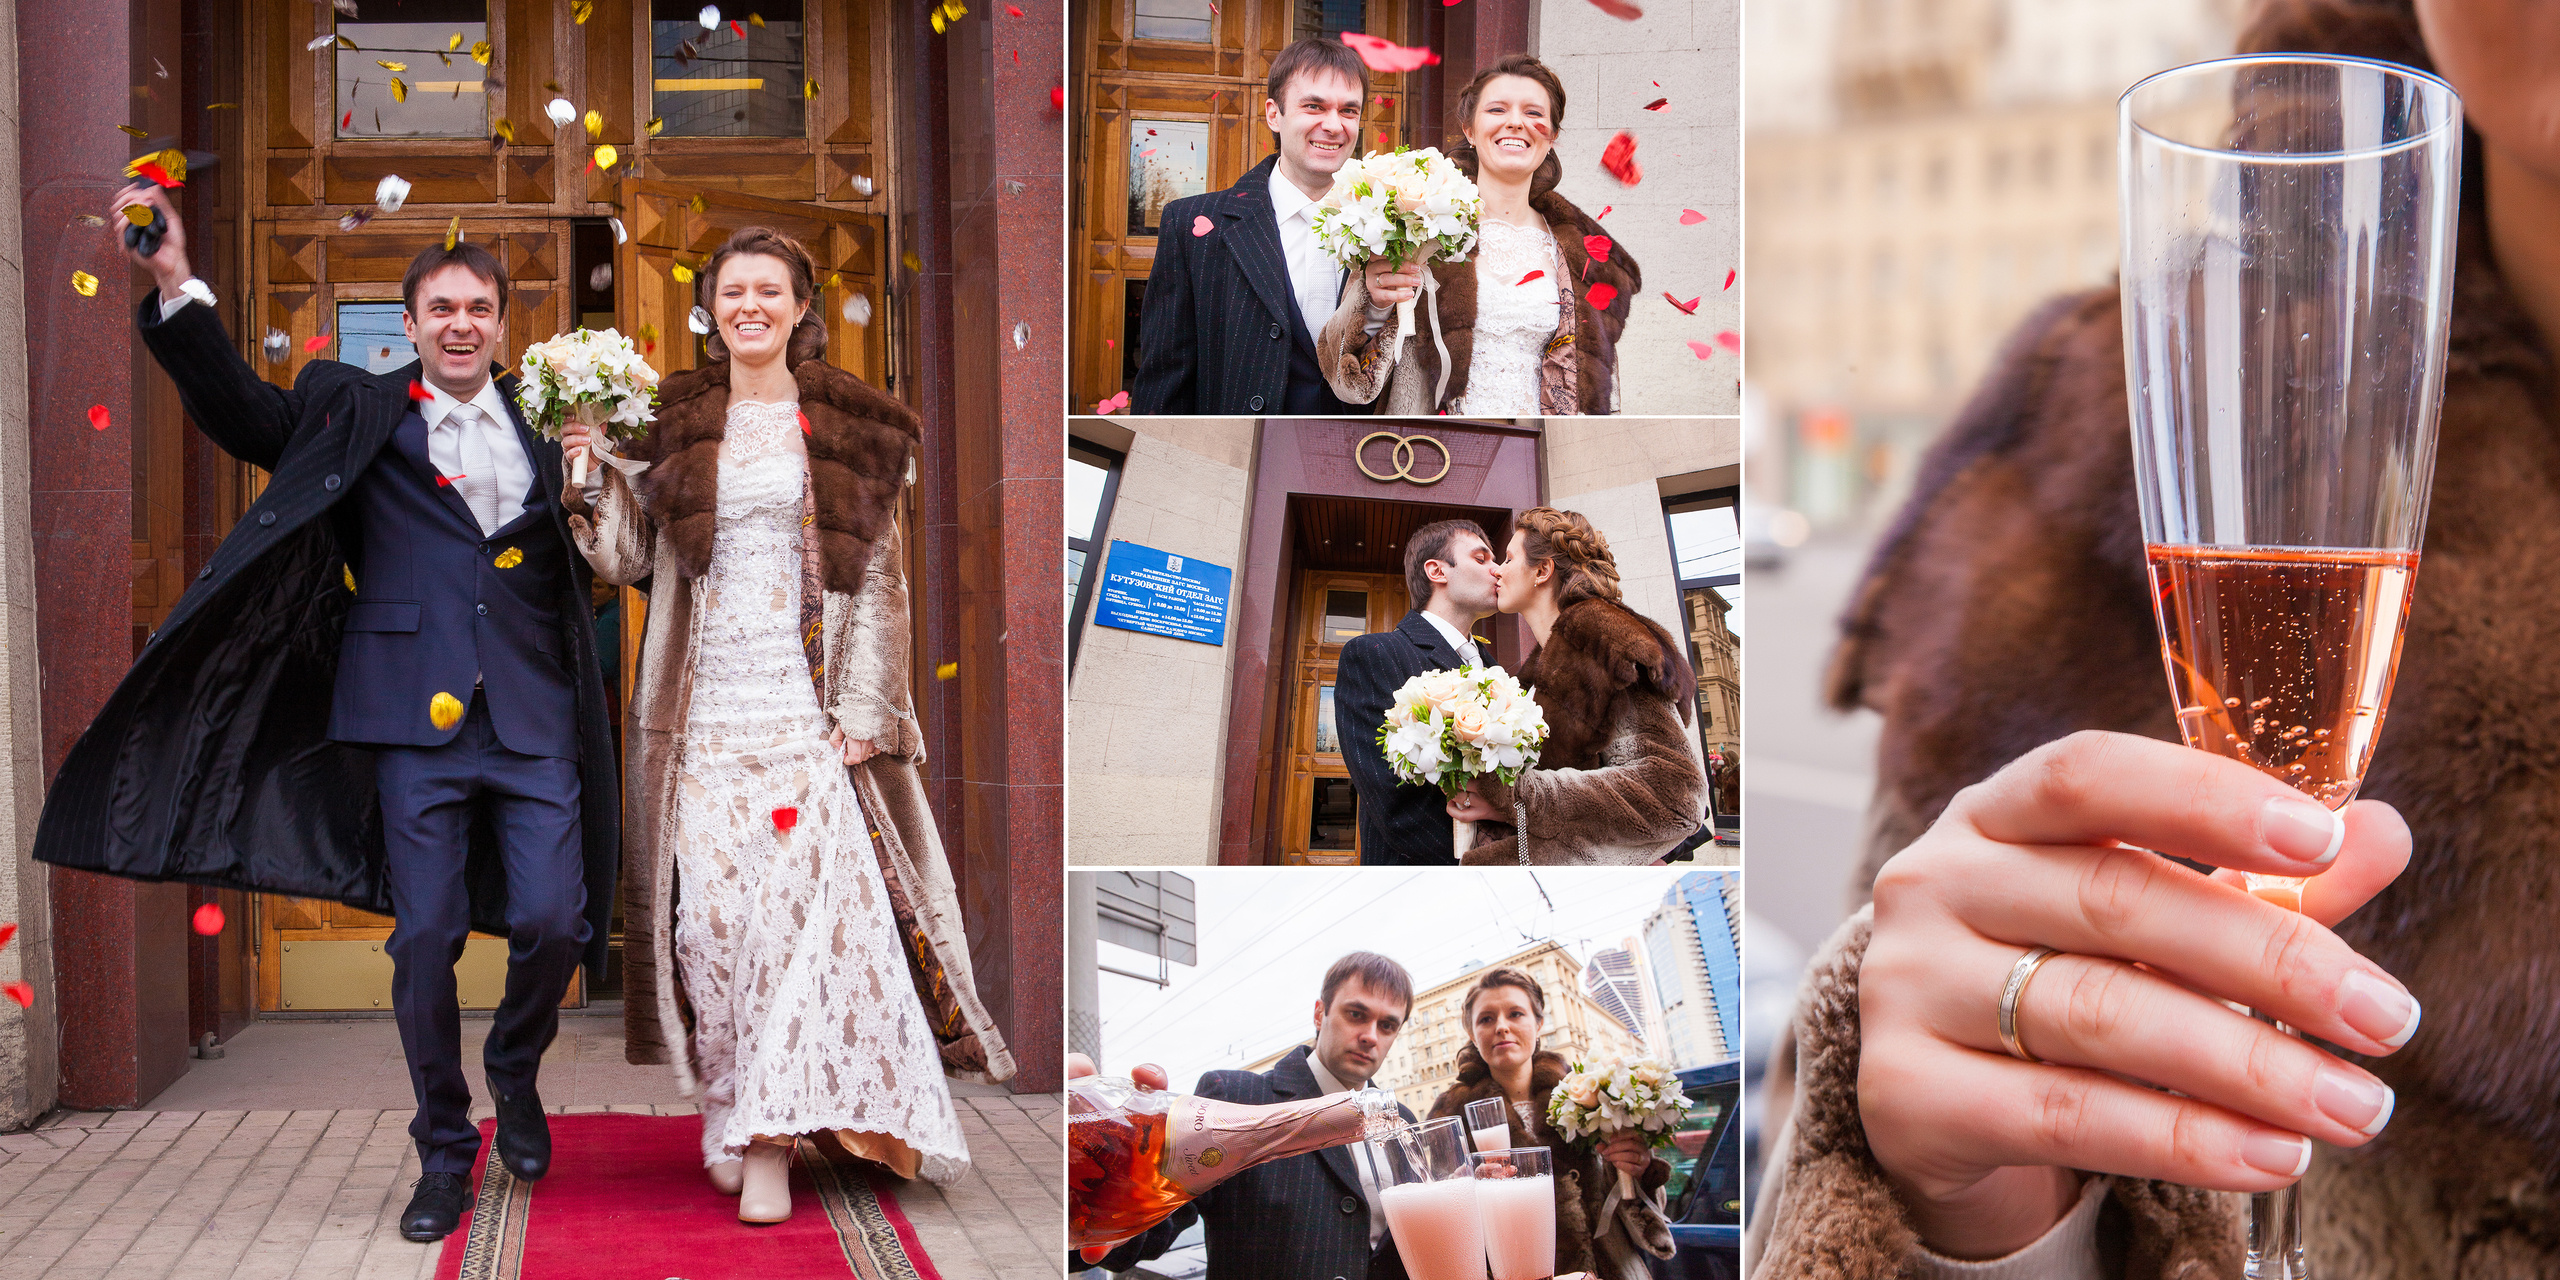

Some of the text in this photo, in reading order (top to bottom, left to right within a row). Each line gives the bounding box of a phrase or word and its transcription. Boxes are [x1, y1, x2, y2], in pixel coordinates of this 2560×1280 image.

[1110, 574, 1224, 605] КУТУЗОВСКИЙ ОТДЕЛ ЗАГС
[1130, 571, 1171, 584] УПРАВЛЕНИЕ
[1186, 583, 1210, 592] МОСКВЫ
[1182, 577, 1201, 585] МОСКВЫ
[1183, 1148, 1199, 1176] Sweet
